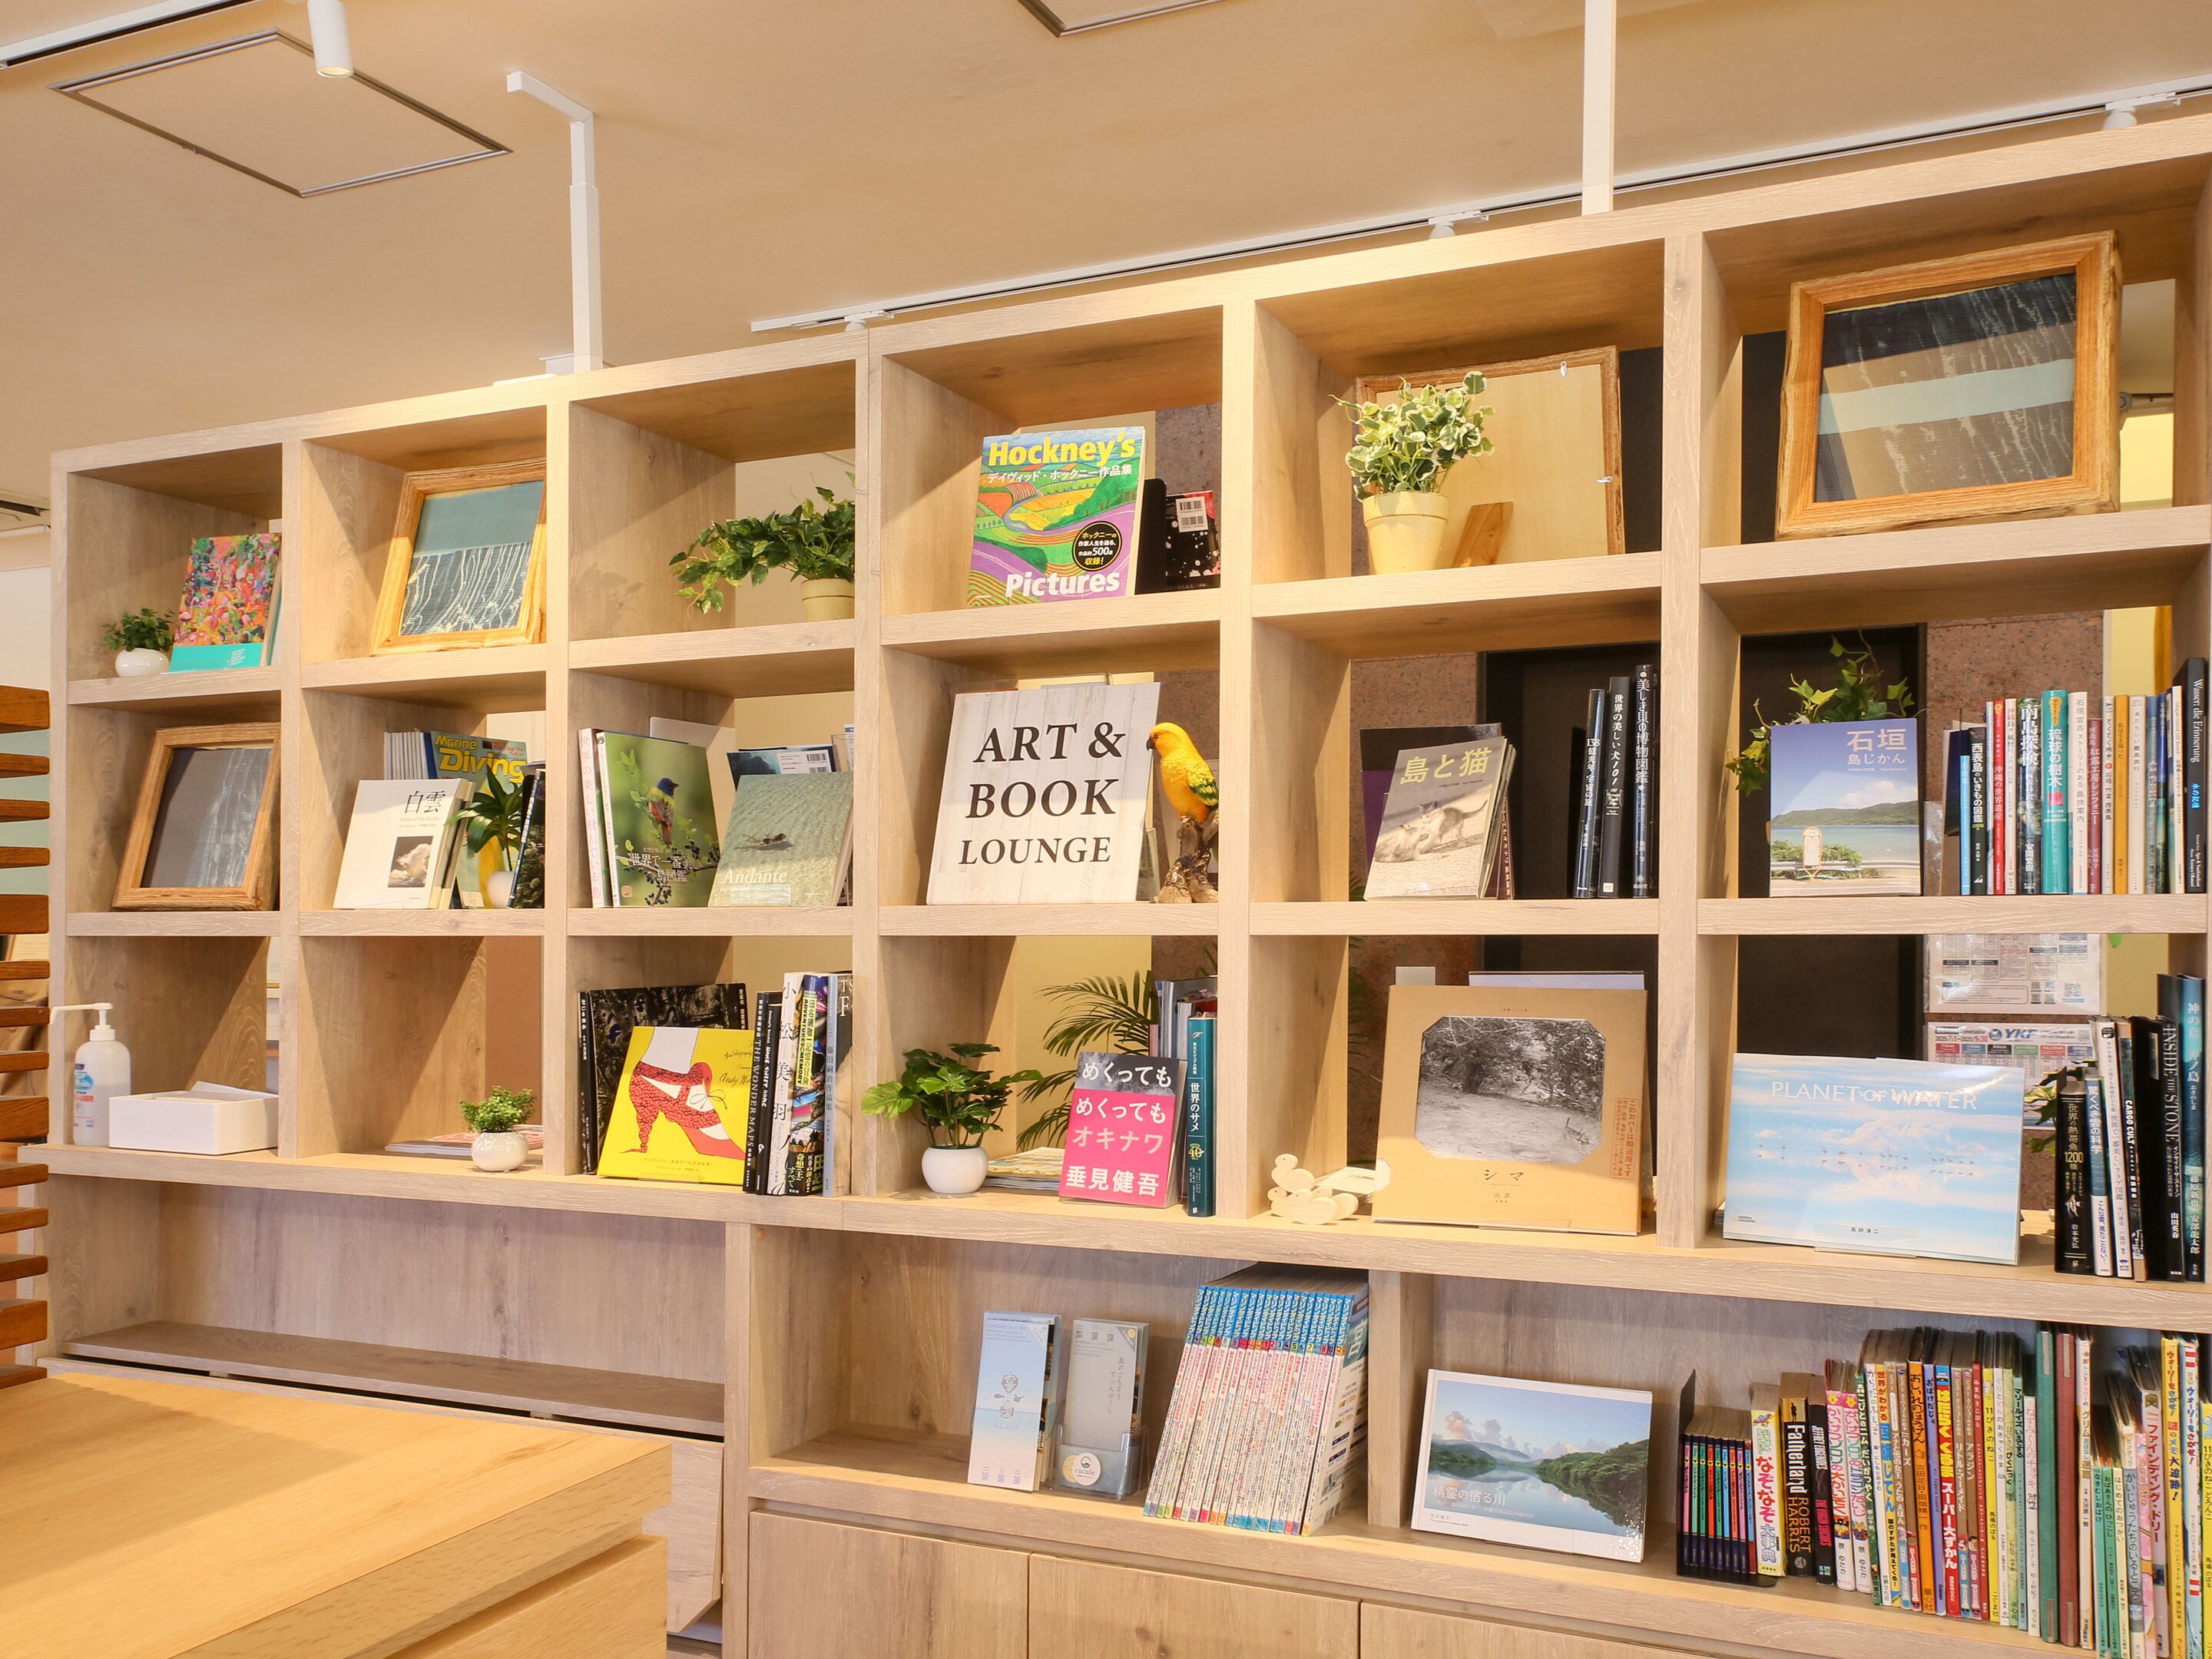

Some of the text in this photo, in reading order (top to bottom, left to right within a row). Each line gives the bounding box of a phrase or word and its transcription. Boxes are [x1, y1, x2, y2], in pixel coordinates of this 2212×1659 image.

[988, 432, 1135, 466] Hockney's
[1005, 571, 1120, 598] Pictures
[1635, 679, 1650, 783] 美しき貝の博物図鑑
[2194, 708, 2204, 719] die
[435, 734, 477, 750] Marine
[973, 722, 1126, 763] ART &
[1846, 728, 1907, 751] 石垣
[2048, 728, 2064, 788] 琉球の樹木
[2190, 720, 2204, 763] Erinnerung
[439, 747, 527, 783] Diving
[1399, 747, 1492, 785] 島と猫
[1847, 753, 1905, 765] 島じかん
[405, 790, 445, 813] 白雲
[965, 779, 1119, 818] BOOK
[959, 836, 1111, 865] LOUNGE
[722, 867, 788, 884] Andante
[753, 1040, 762, 1062] THE
[773, 982, 796, 1121] 小松美羽
[2005, 1028, 2037, 1039] YKF
[2163, 1027, 2178, 1077] INSIDE
[750, 1065, 760, 1116] WONDER
[1082, 1062, 1172, 1088] めくっても
[1075, 1098, 1166, 1124] めくっても
[1190, 1082, 1200, 1132] 世界のサメ
[1772, 1081, 1979, 1111] PLANET OF WATER
[747, 1117, 757, 1150] MAPS
[2088, 1085, 2103, 1154] 驚くべき雲の科学
[2124, 1100, 2135, 1144] CARGO CULT
[2164, 1094, 2180, 1143] STONE
[1072, 1125, 1164, 1154] オキナワ
[1065, 1164, 1160, 1197] 垂見健吾
[1484, 1169, 1524, 1181] シマ
[2190, 1174, 2200, 1254] 藤原新也 安部龍太郎
[1910, 1373, 1925, 1444] おしいれのぼうけん
[1936, 1389, 1952, 1439] はたらく
[1877, 1370, 1895, 1512] 世界がわかる じてん
[1901, 1438, 1912, 1466] カーズ
[1985, 1407, 1995, 1462] 11ぴきのねこ
[2025, 1407, 2036, 1488] ねずみくんのチョッキ
[1861, 1449, 1873, 1502] だいかつやく
[1939, 1442, 1955, 1479] くるま
[1955, 1442, 1966, 1512] リトル・マーメイド
[1965, 1442, 1975, 1480] アラジン
[1434, 1485, 1506, 1507] 精霊の宿る川
[1786, 1425, 1812, 1553] Fatherland ROBERT HARRIS
[2147, 1424, 2161, 1543] ファインディング・ドリー
[2114, 1477, 2125, 1542] はじめてのおつかい
[2125, 1473, 2139, 1601] かいじゅうたちのいるところ
